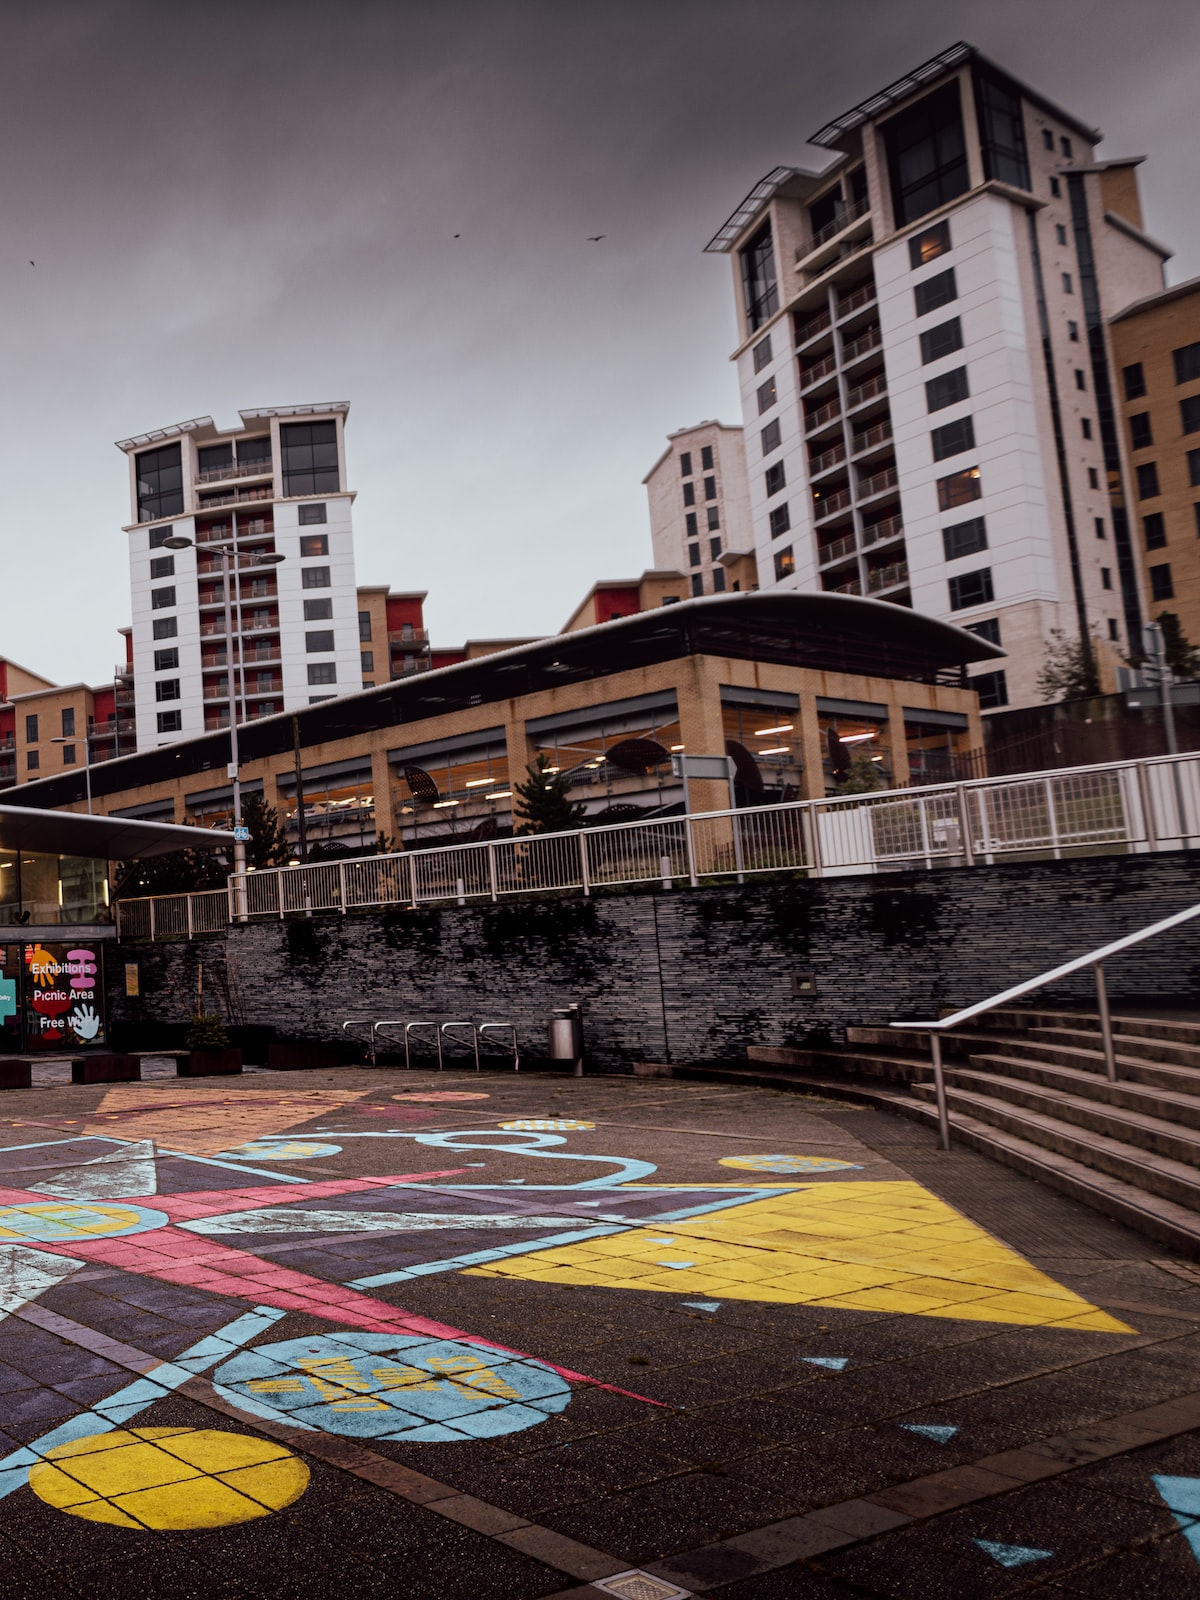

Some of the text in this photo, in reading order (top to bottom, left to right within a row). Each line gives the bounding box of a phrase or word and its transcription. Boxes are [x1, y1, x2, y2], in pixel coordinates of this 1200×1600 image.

[32, 962, 91, 975] Exhibitions
[33, 989, 94, 1001] Picnic Area
[40, 1017, 65, 1029] Free
